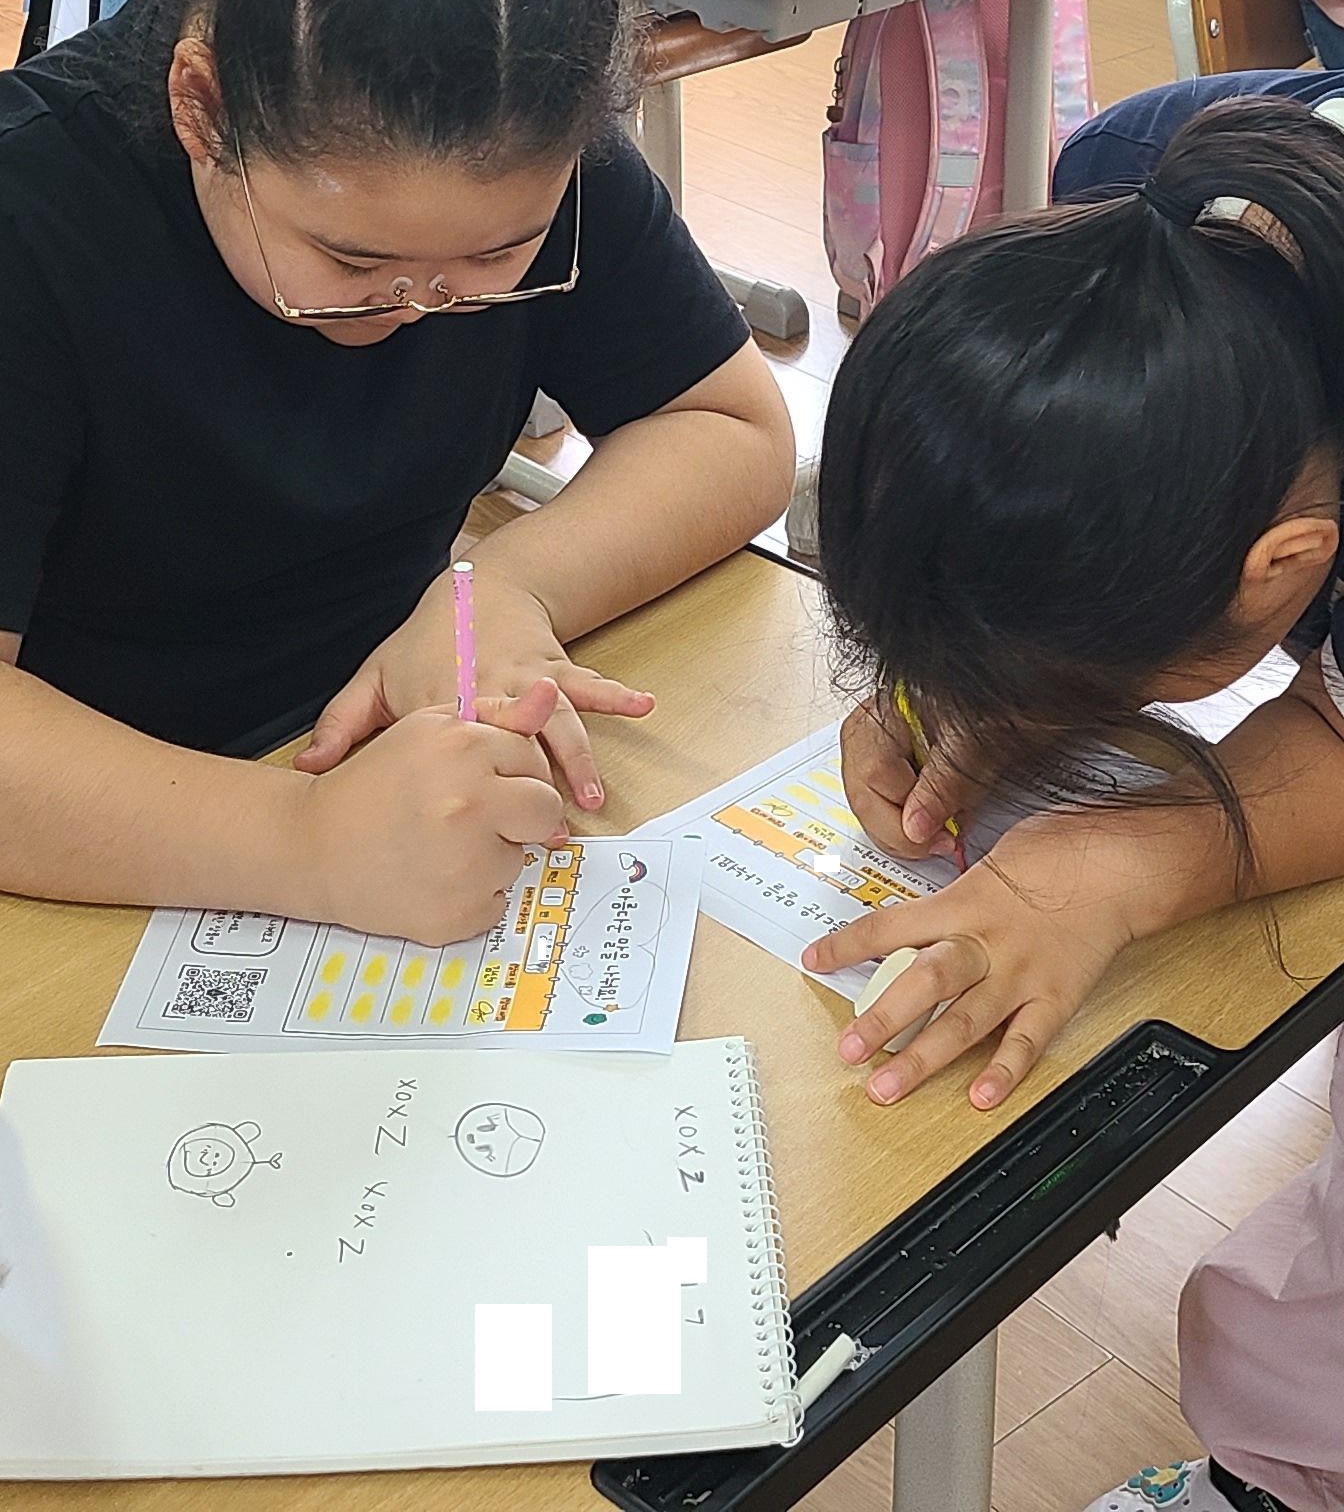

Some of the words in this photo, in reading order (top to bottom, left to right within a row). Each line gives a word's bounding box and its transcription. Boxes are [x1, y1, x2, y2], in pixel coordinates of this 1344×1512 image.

[709, 854, 764, 886] 나눠요!
[607, 887, 638, 934] 아름다운
[762, 882, 798, 908] 말을
[800, 902, 848, 934] 름다운
[600, 938, 632, 961] 말을
[595, 964, 621, 1001] 나눠요!
